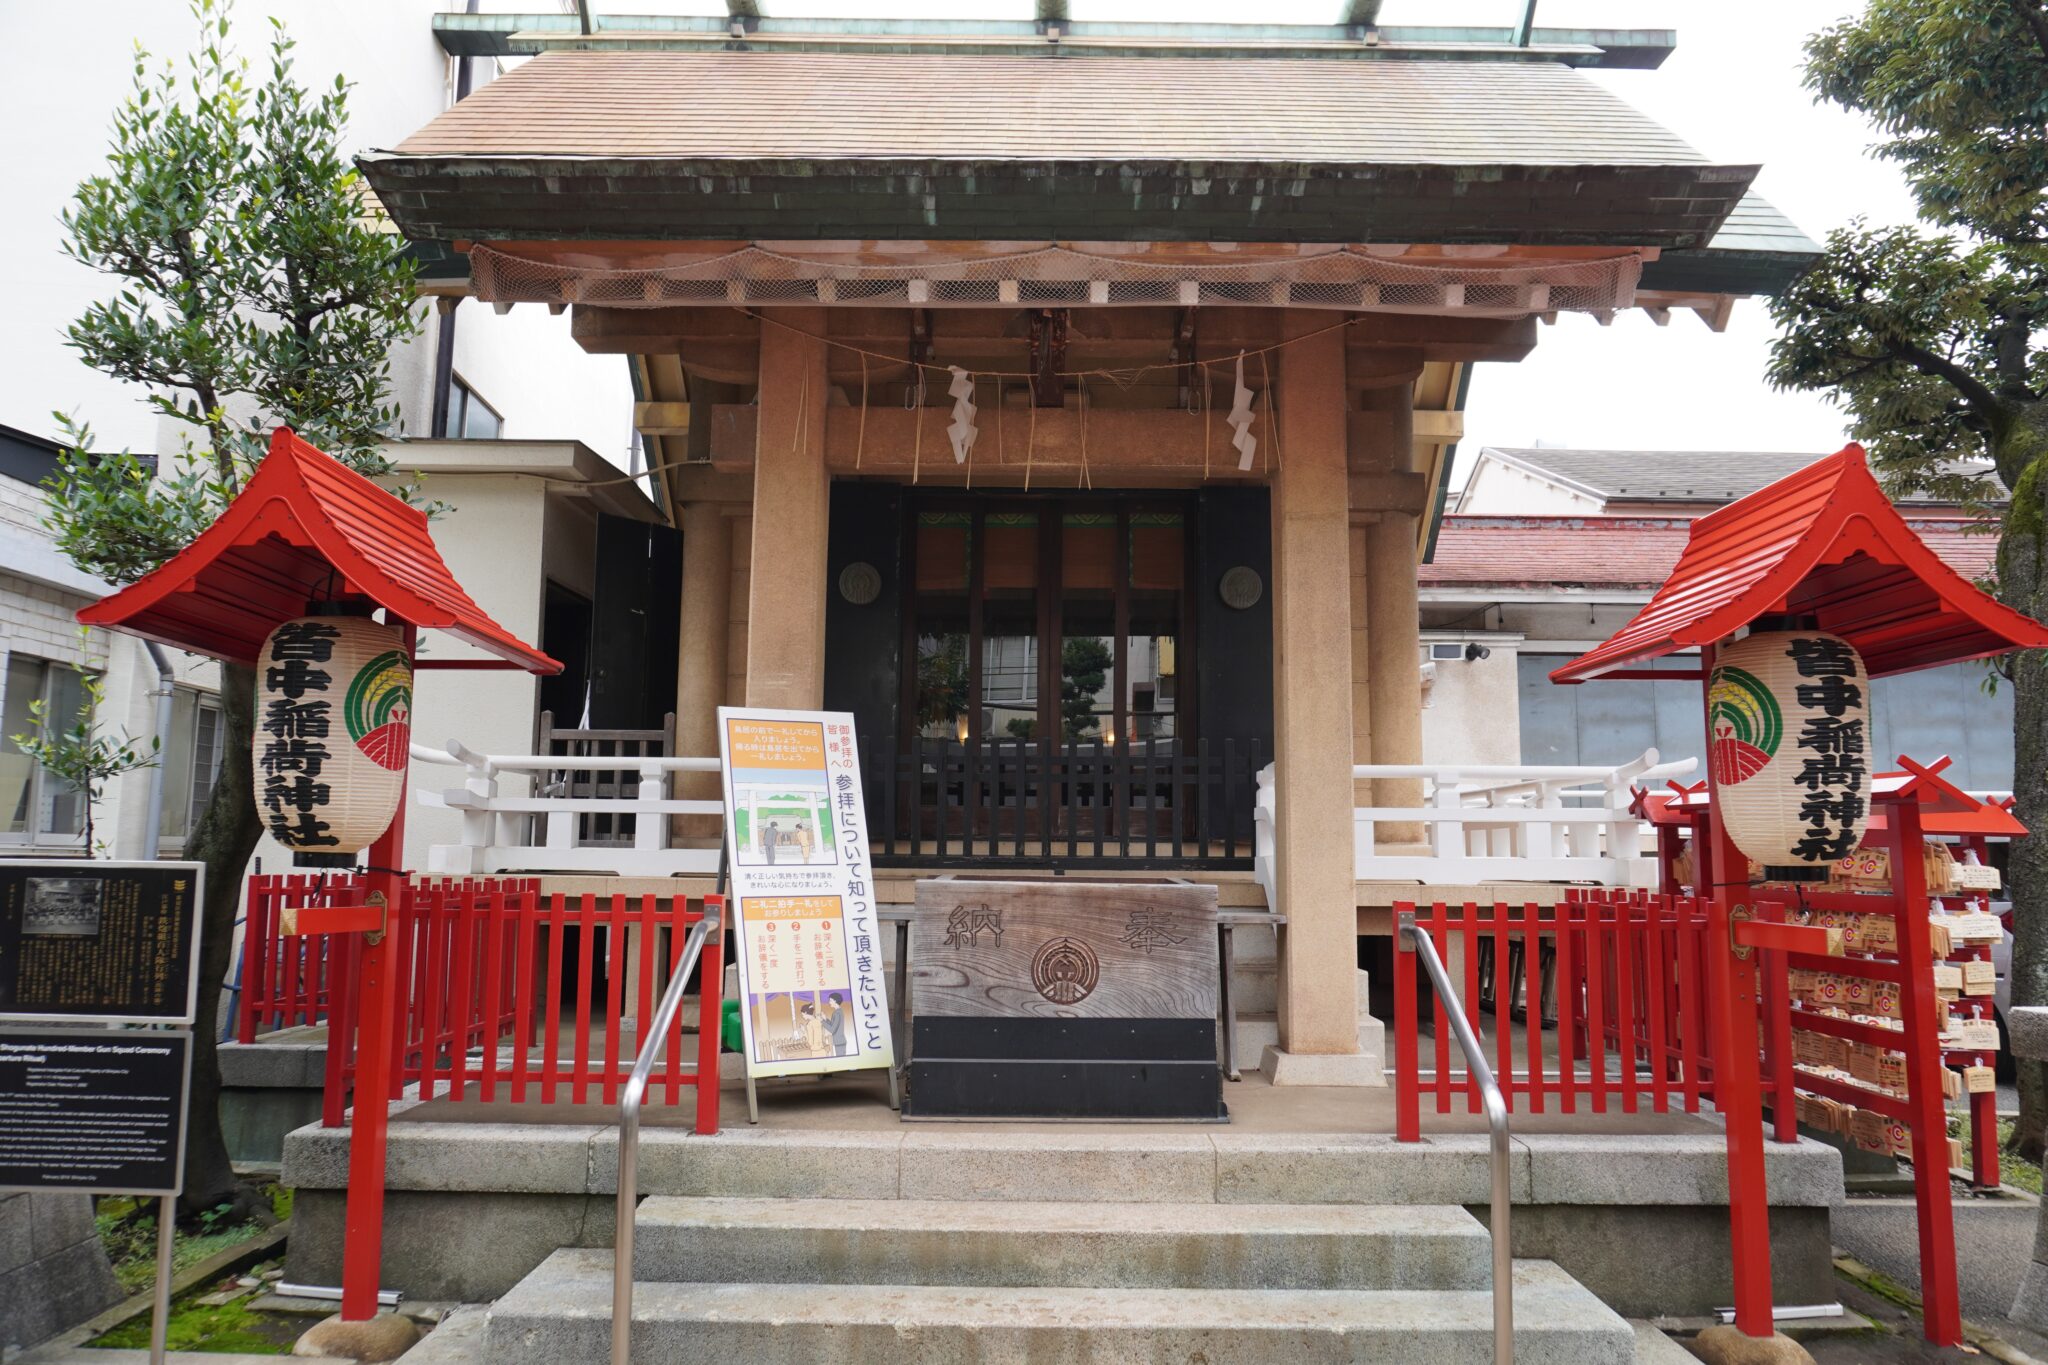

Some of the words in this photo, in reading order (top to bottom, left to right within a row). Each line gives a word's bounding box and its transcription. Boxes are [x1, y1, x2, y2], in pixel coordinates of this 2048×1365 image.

[259, 622, 341, 847] 皆中稲荷神社
[839, 724, 853, 769] 御参拝の
[1785, 637, 1867, 862] 皆中稲荷神社
[764, 908, 823, 917] お参りしましょう
[836, 774, 882, 1050] 参拝について知って頂きたいこと
[943, 903, 1005, 950] 納
[1118, 906, 1188, 954] 奉
[768, 934, 778, 968] 深く一度
[793, 934, 806, 987] 手を二度打つ
[823, 933, 834, 968] 深く二度
